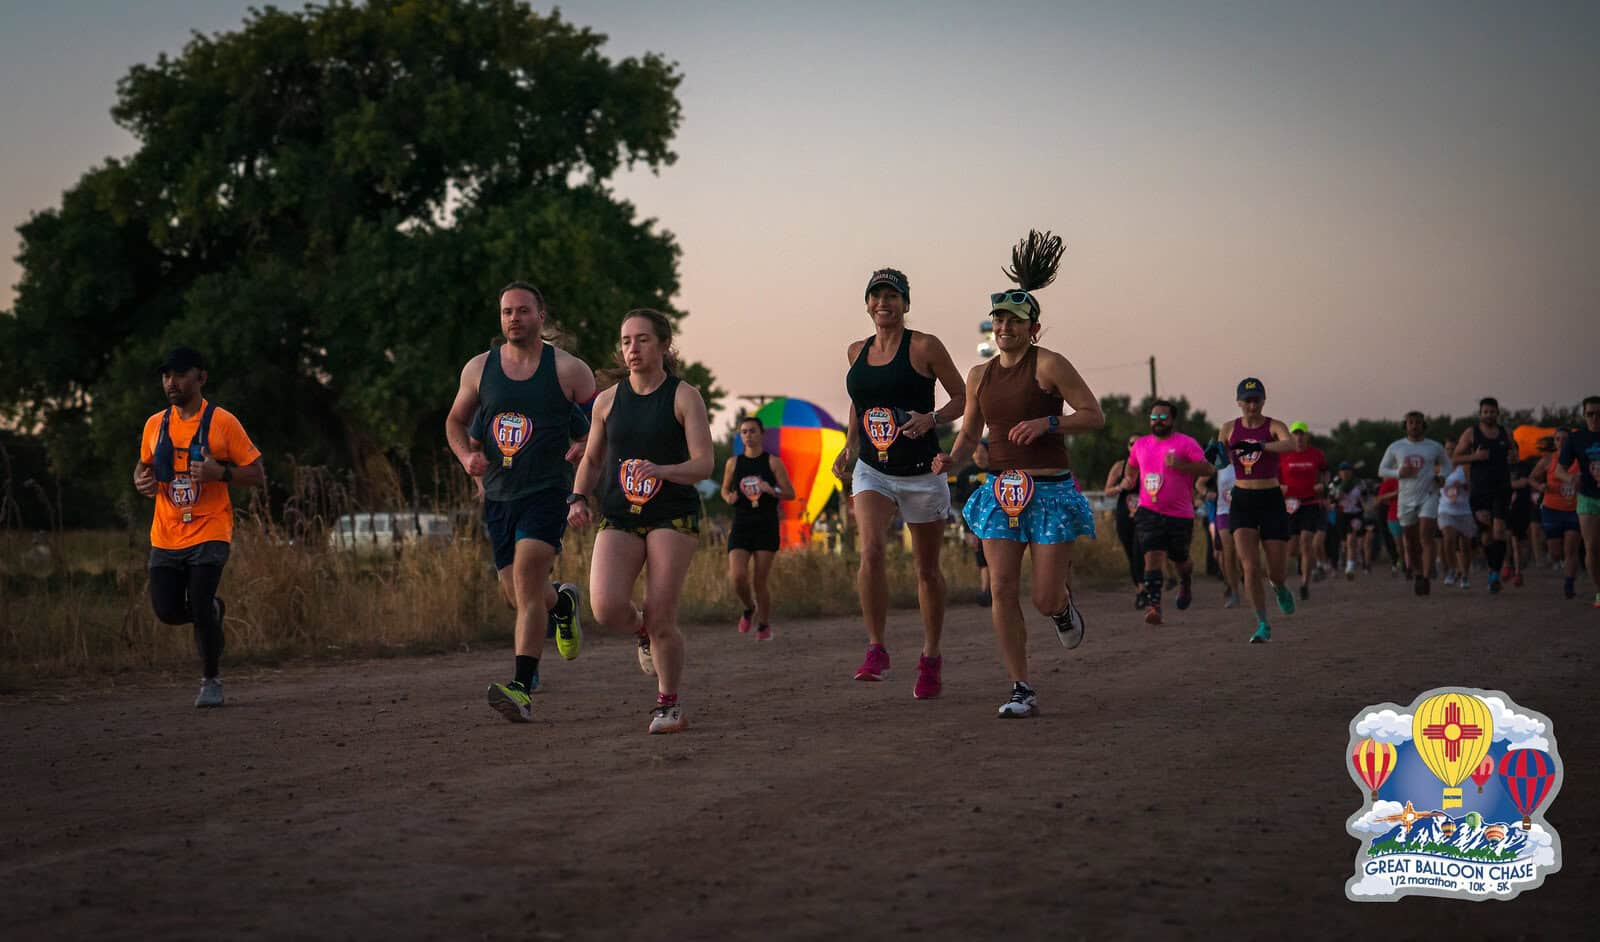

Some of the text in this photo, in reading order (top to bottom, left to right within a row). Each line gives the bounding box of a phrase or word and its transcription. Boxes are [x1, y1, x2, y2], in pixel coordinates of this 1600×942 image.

[499, 428, 522, 443] 610
[871, 423, 893, 437] 632
[173, 488, 195, 503] 620
[1000, 487, 1024, 501] 738
